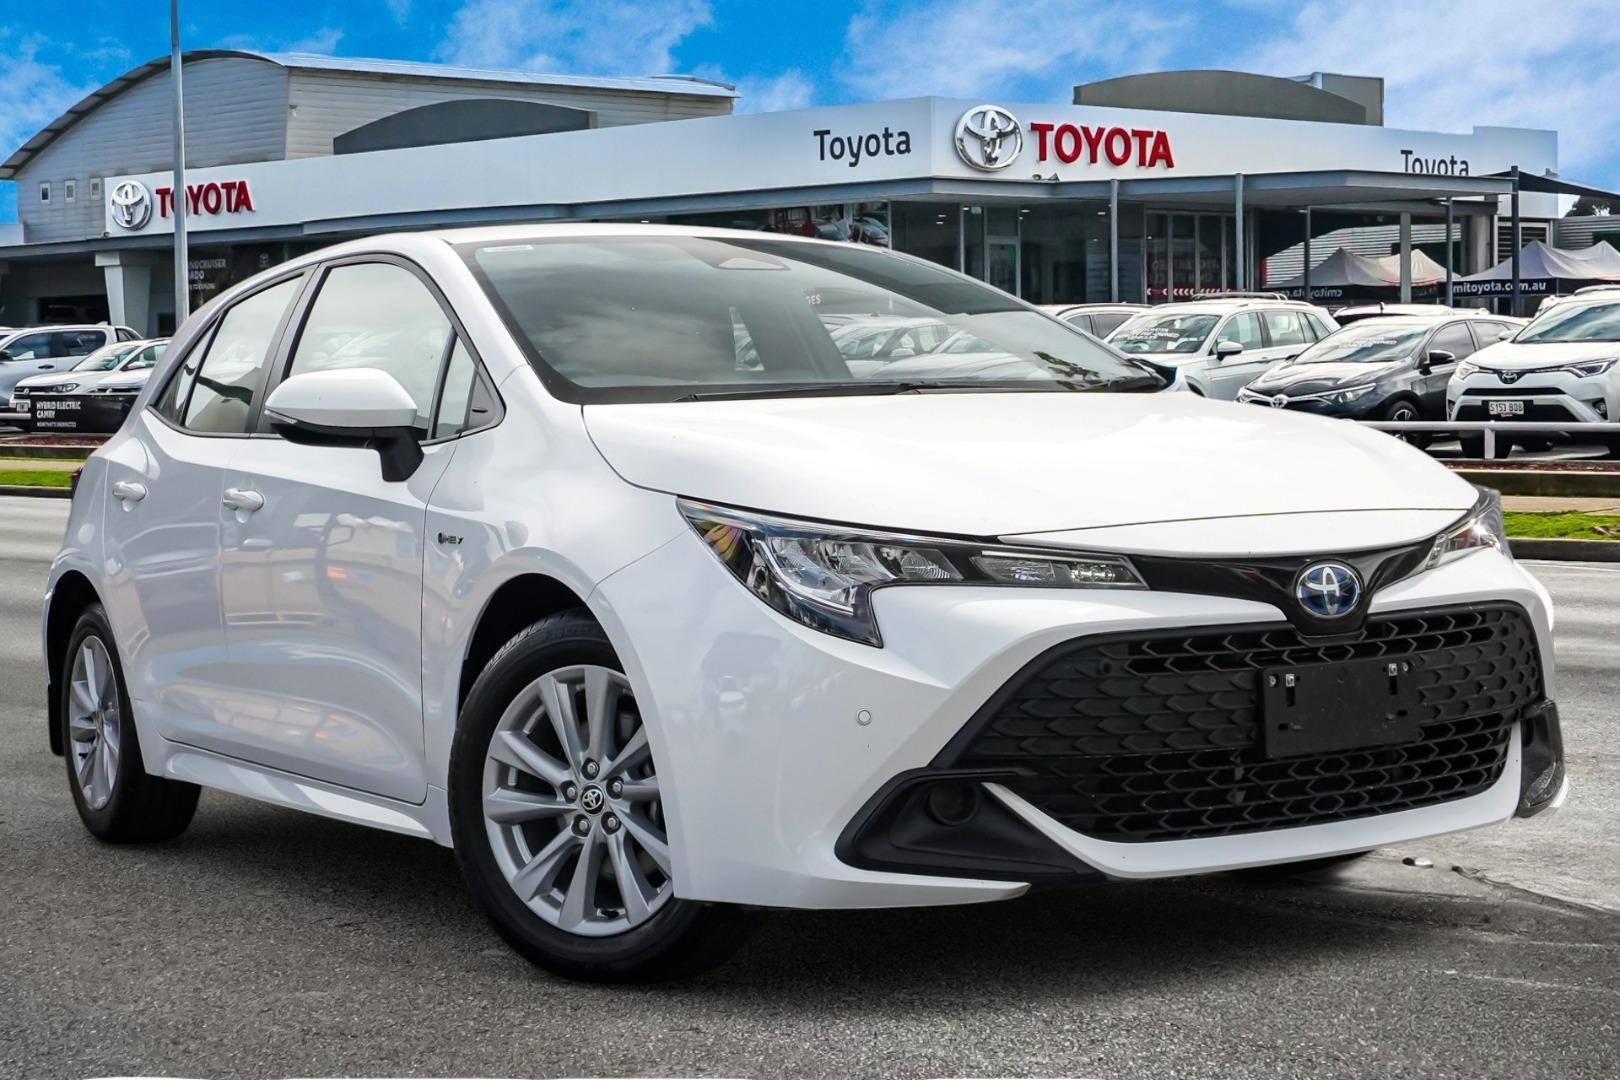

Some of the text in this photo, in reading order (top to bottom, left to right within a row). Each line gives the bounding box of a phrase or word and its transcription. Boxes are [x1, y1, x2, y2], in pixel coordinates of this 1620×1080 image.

[813, 127, 911, 167] Toyota
[1030, 122, 1174, 168] TOYOTA
[1453, 281, 1546, 295] mitoyota.cm.au
[36, 401, 56, 410] HYBRID
[56, 401, 81, 410] ELECTRIC
